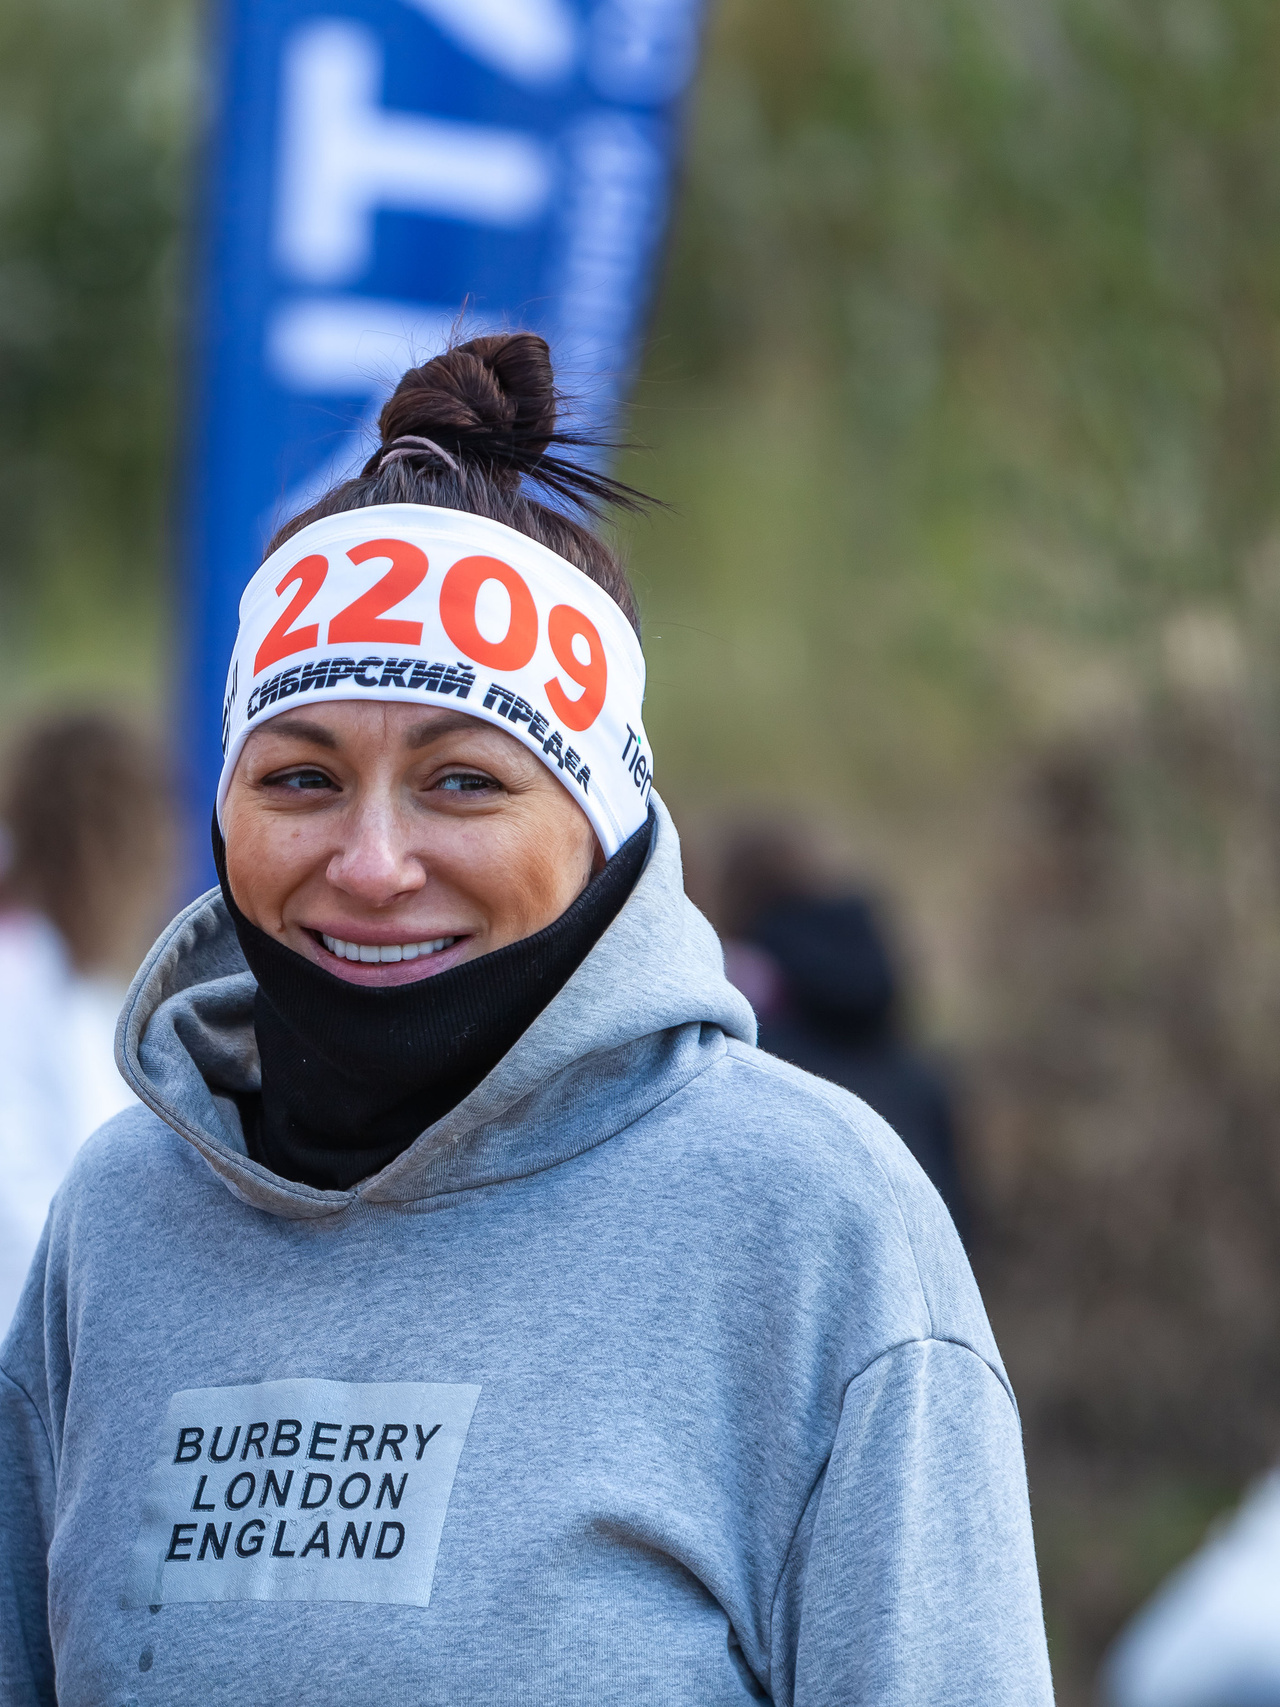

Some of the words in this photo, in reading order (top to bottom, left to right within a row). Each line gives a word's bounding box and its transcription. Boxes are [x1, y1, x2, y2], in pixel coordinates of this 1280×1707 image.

[252, 538, 608, 732] 2209
[247, 656, 476, 721] СИБИРСКИЙ
[482, 682, 591, 796] ПРЕДЕЛ
[171, 1419, 443, 1466] BURBERRY
[190, 1469, 409, 1512] LONDON
[165, 1518, 406, 1562] ENGLAND
